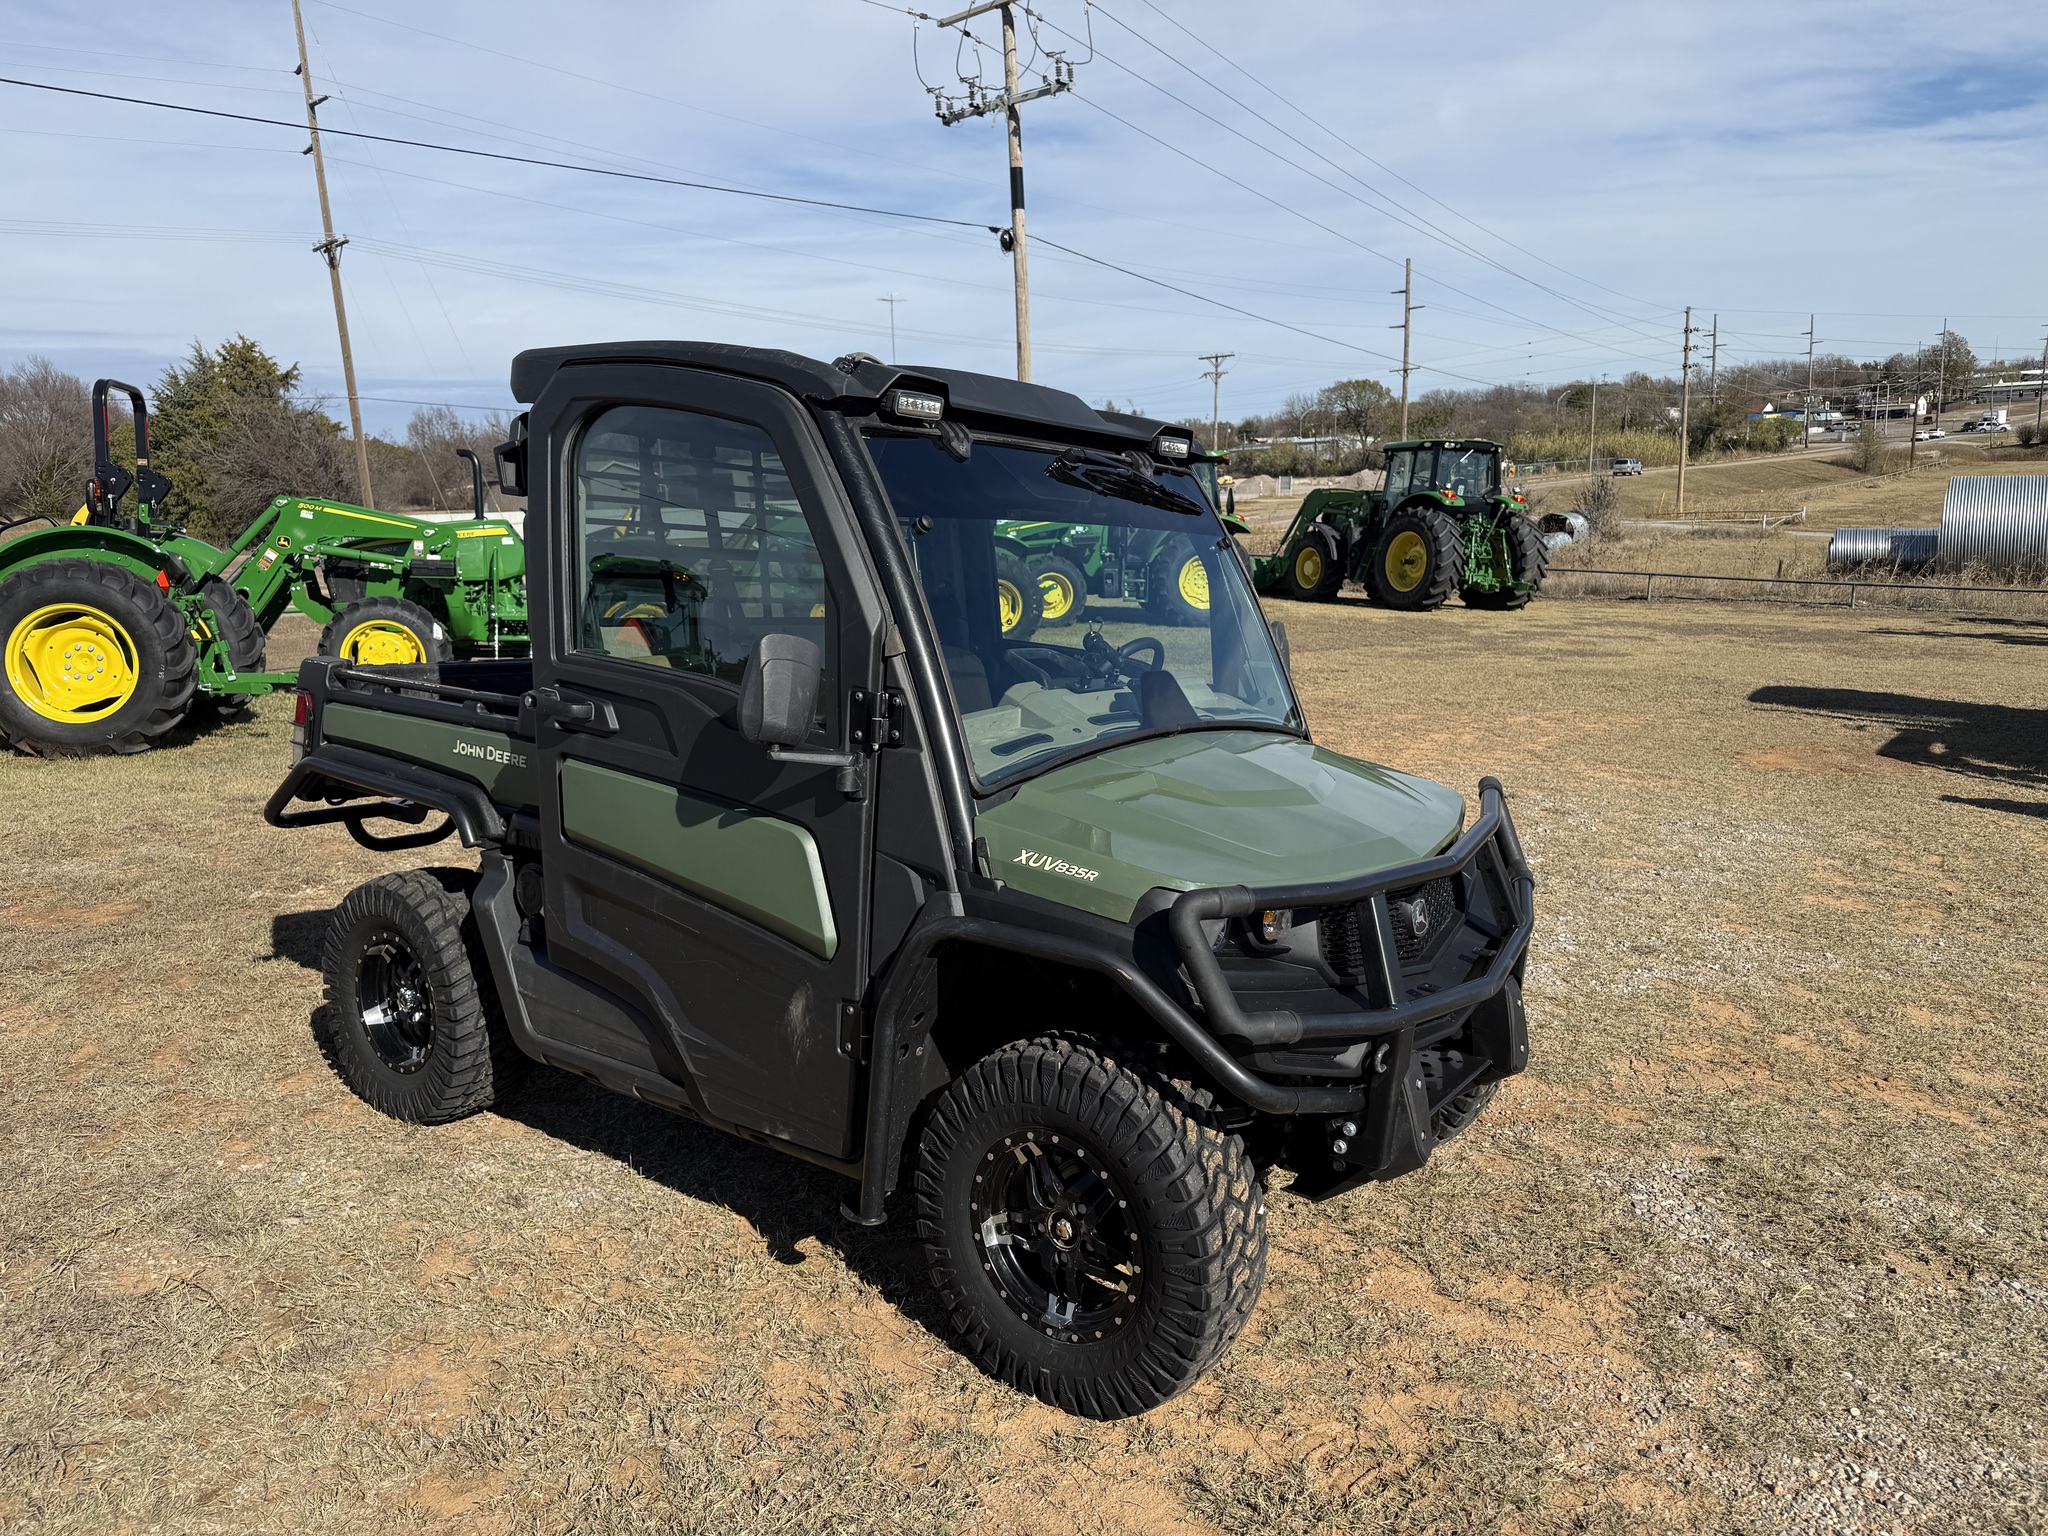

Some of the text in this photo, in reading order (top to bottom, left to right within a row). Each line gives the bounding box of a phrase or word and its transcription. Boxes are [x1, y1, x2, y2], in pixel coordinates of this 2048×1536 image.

[453, 739, 527, 768] JOHN DEERE
[1011, 848, 1100, 882] XUV835R
